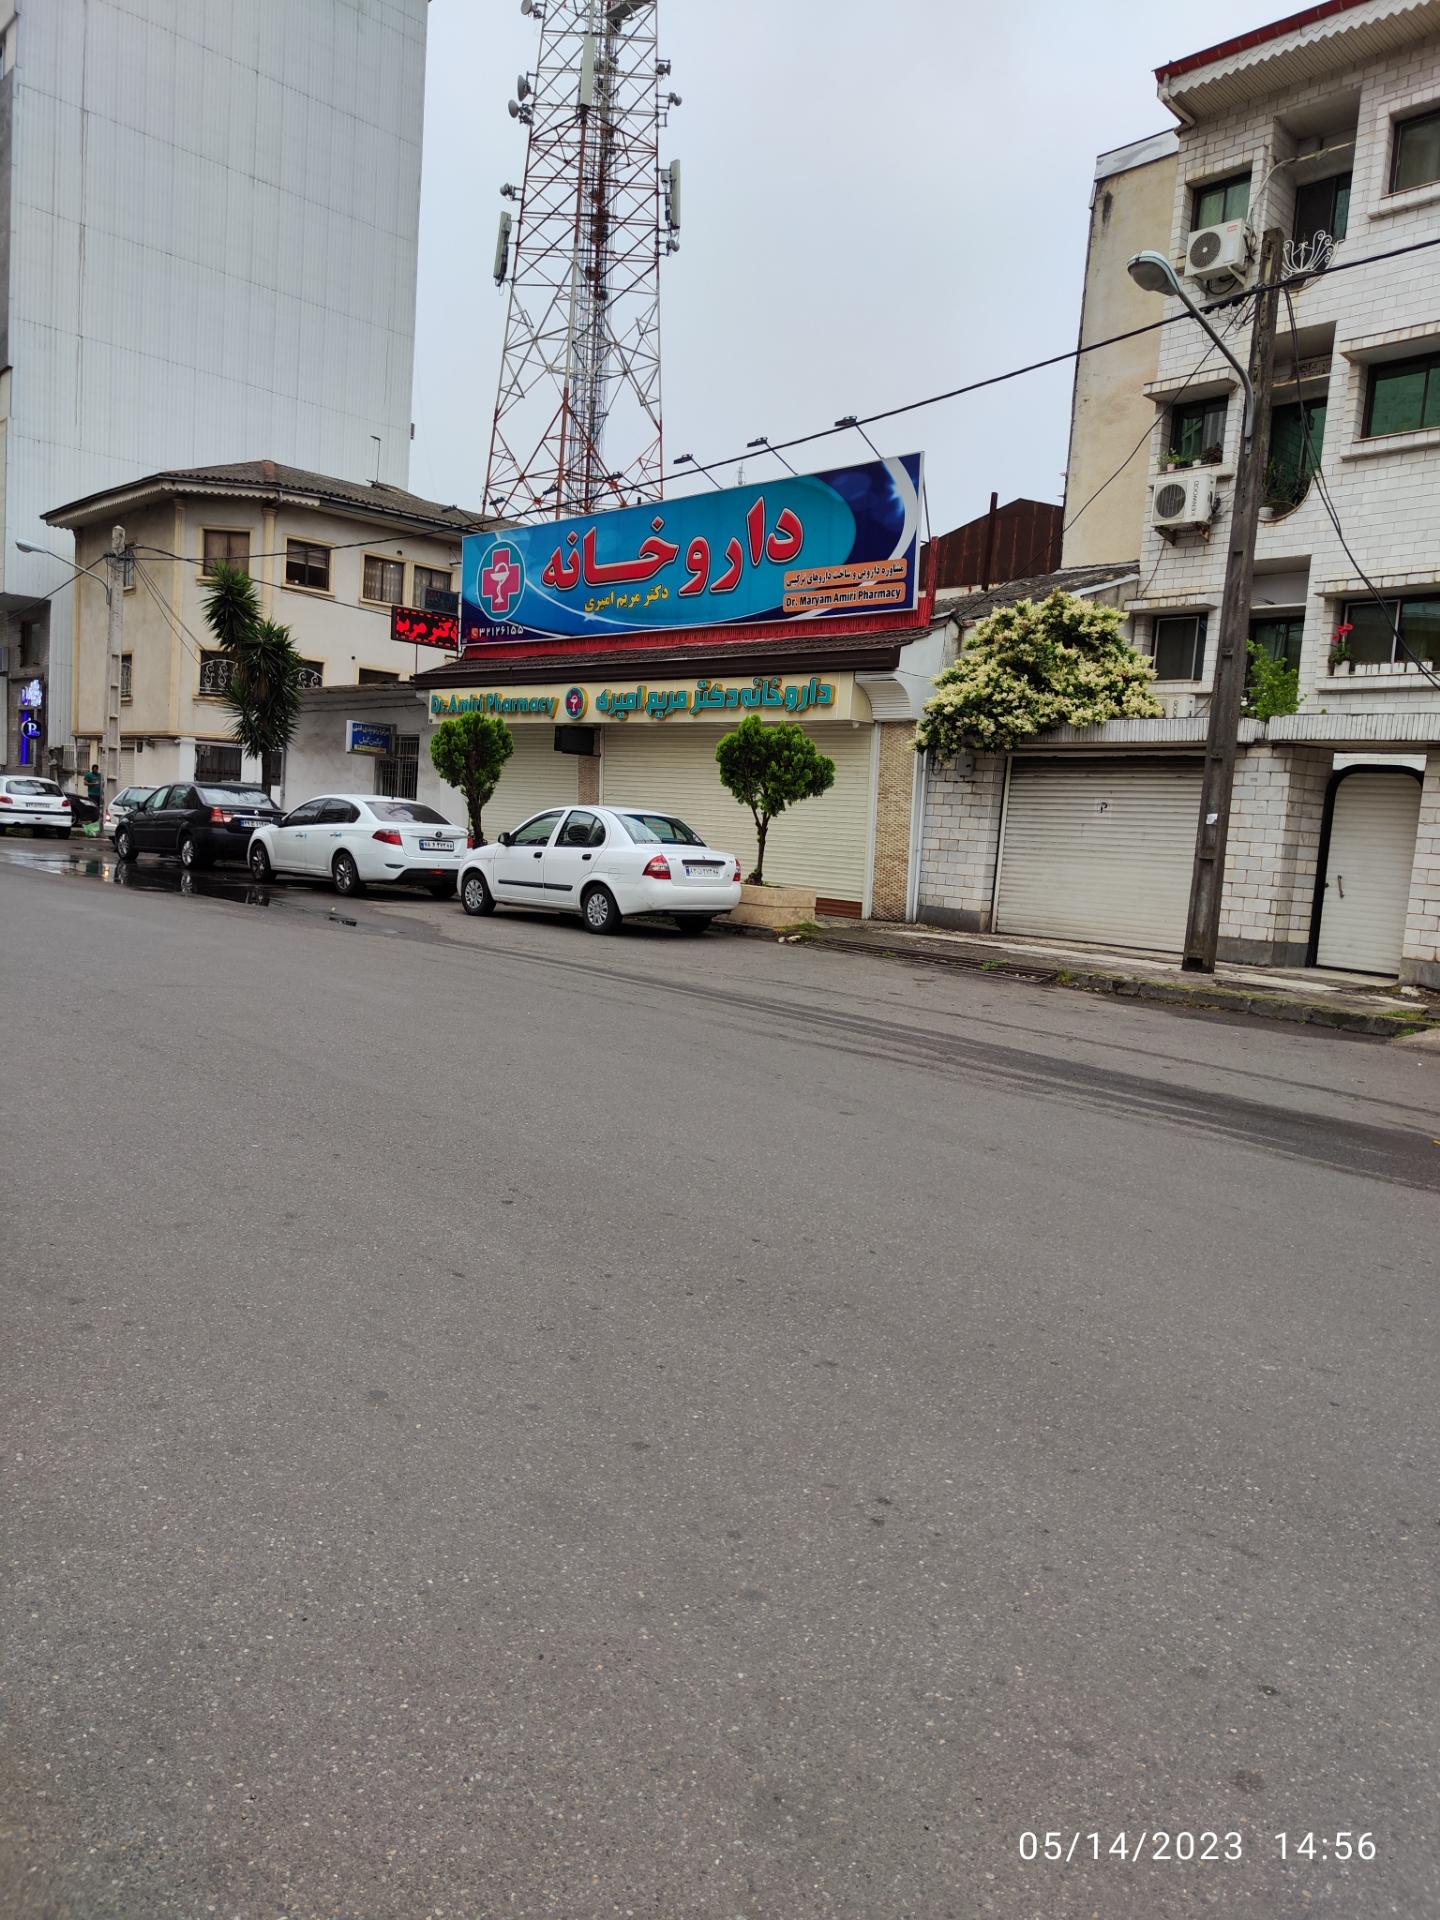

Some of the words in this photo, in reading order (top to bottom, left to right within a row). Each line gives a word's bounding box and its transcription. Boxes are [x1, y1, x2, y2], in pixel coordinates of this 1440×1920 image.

[541, 496, 805, 596] داروخانه
[806, 572, 832, 585] داروهای
[852, 571, 856, 581] و
[881, 562, 904, 577] مشاوره
[584, 591, 614, 612] امیری
[616, 593, 640, 609] مریم
[642, 583, 669, 607] دکتر
[786, 597, 798, 607] Dr.
[800, 595, 832, 606] Maryam
[833, 592, 856, 602] Amiri
[858, 588, 901, 600] Pharmacy
[486, 692, 558, 719] Pharmacy
[596, 685, 645, 719] امیری
[645, 690, 690, 719] مریم
[689, 679, 739, 715] دکتر
[740, 676, 834, 713] داروخانه
